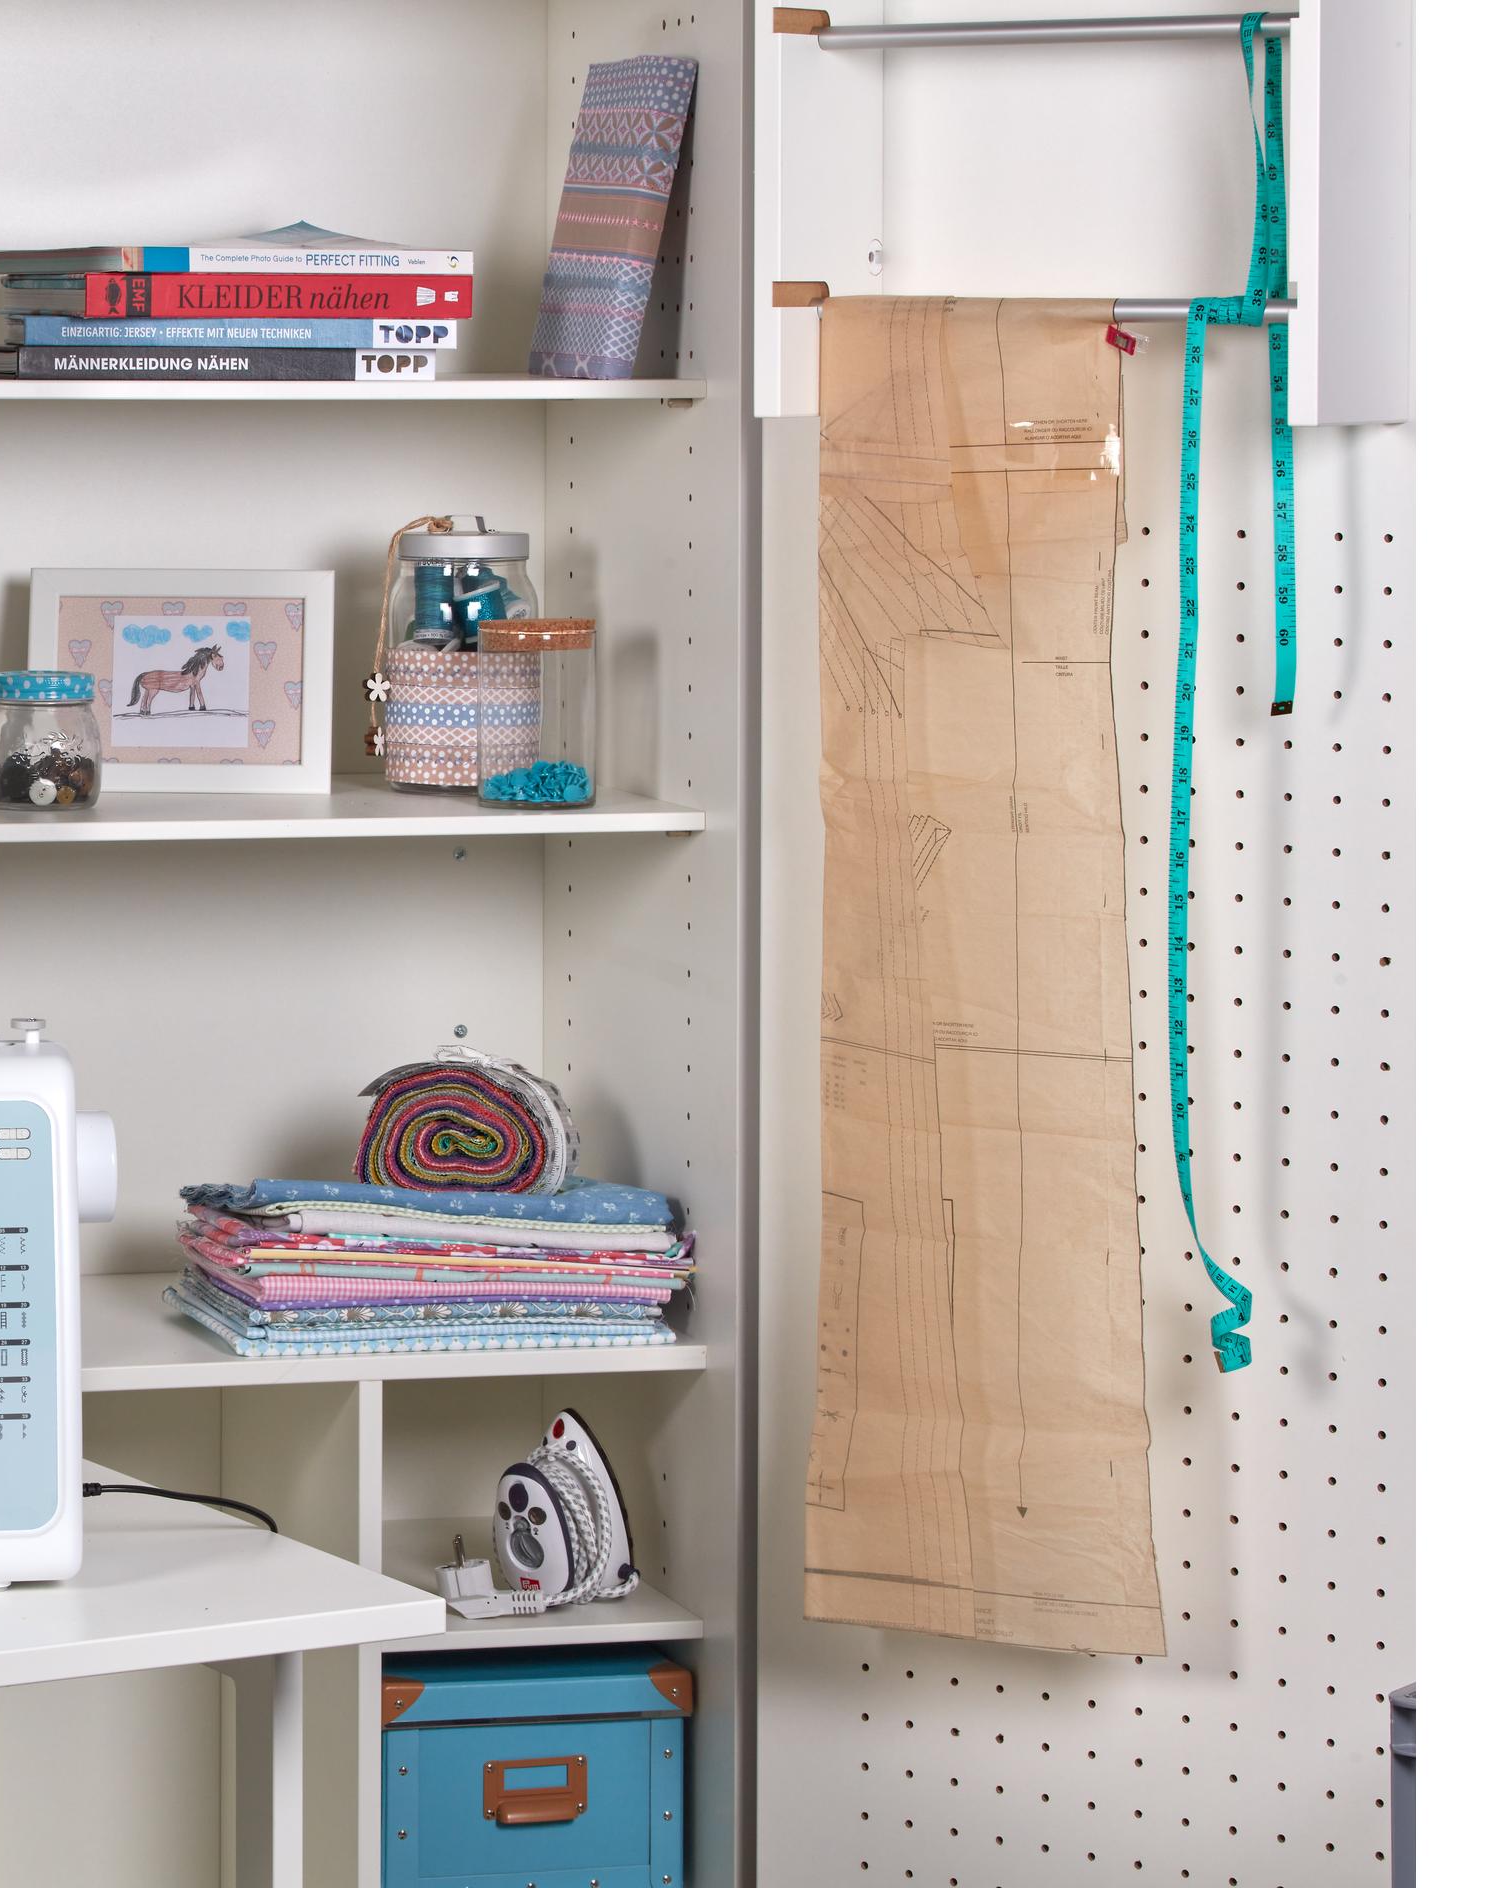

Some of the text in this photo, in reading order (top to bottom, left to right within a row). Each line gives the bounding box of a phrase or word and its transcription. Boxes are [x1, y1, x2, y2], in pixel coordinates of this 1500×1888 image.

[1270, 206, 1279, 223] 50
[201, 254, 214, 262] The
[216, 254, 249, 263] Complete
[251, 254, 271, 262] Photo
[273, 255, 294, 263] Guide
[306, 254, 356, 266] PERFECT
[359, 255, 400, 267] FITTING
[1258, 247, 1267, 264] 39
[132, 279, 145, 312] EMF
[178, 284, 389, 310] KLEIDER nähen
[1252, 289, 1263, 305] 38
[1195, 305, 1204, 321] 29
[61, 326, 312, 339] EINZIGARTIG: JERSEY EFFEKTE MIT NEUEN TECHNIKEN
[379, 325, 449, 344] TOPP
[1272, 333, 1281, 351] 53
[54, 355, 249, 371] MÄNNERKLEIDUNG NÄHEN
[361, 354, 428, 373] TOPP
[1192, 346, 1200, 364] 28
[1274, 376, 1283, 392] 54
[1189, 389, 1199, 406] 27
[1275, 418, 1284, 435] 55
[1188, 430, 1197, 448] 26
[1276, 460, 1285, 478] 56
[1187, 473, 1196, 490] 25
[1277, 502, 1286, 520] 57
[1186, 515, 1195, 533] 24
[1278, 545, 1287, 562] 58
[1186, 557, 1195, 574] 23
[1279, 587, 1288, 604] 59
[1187, 599, 1195, 617] 22
[1279, 629, 1289, 646] 60
[1185, 642, 1194, 659] 21
[1182, 683, 1191, 701] 20
[1181, 725, 1189, 742] 19
[1179, 767, 1188, 784] 18
[1177, 810, 1186, 827] 17
[1176, 851, 1184, 869] 16
[1175, 893, 1183, 911] 15
[1174, 936, 1183, 953] 14
[1175, 978, 1183, 995] 13
[1175, 1020, 1183, 1036] 12
[1176, 1061, 1184, 1078] 11
[1177, 1103, 1185, 1120] 10
[1238, 1312, 1245, 1322] 4
